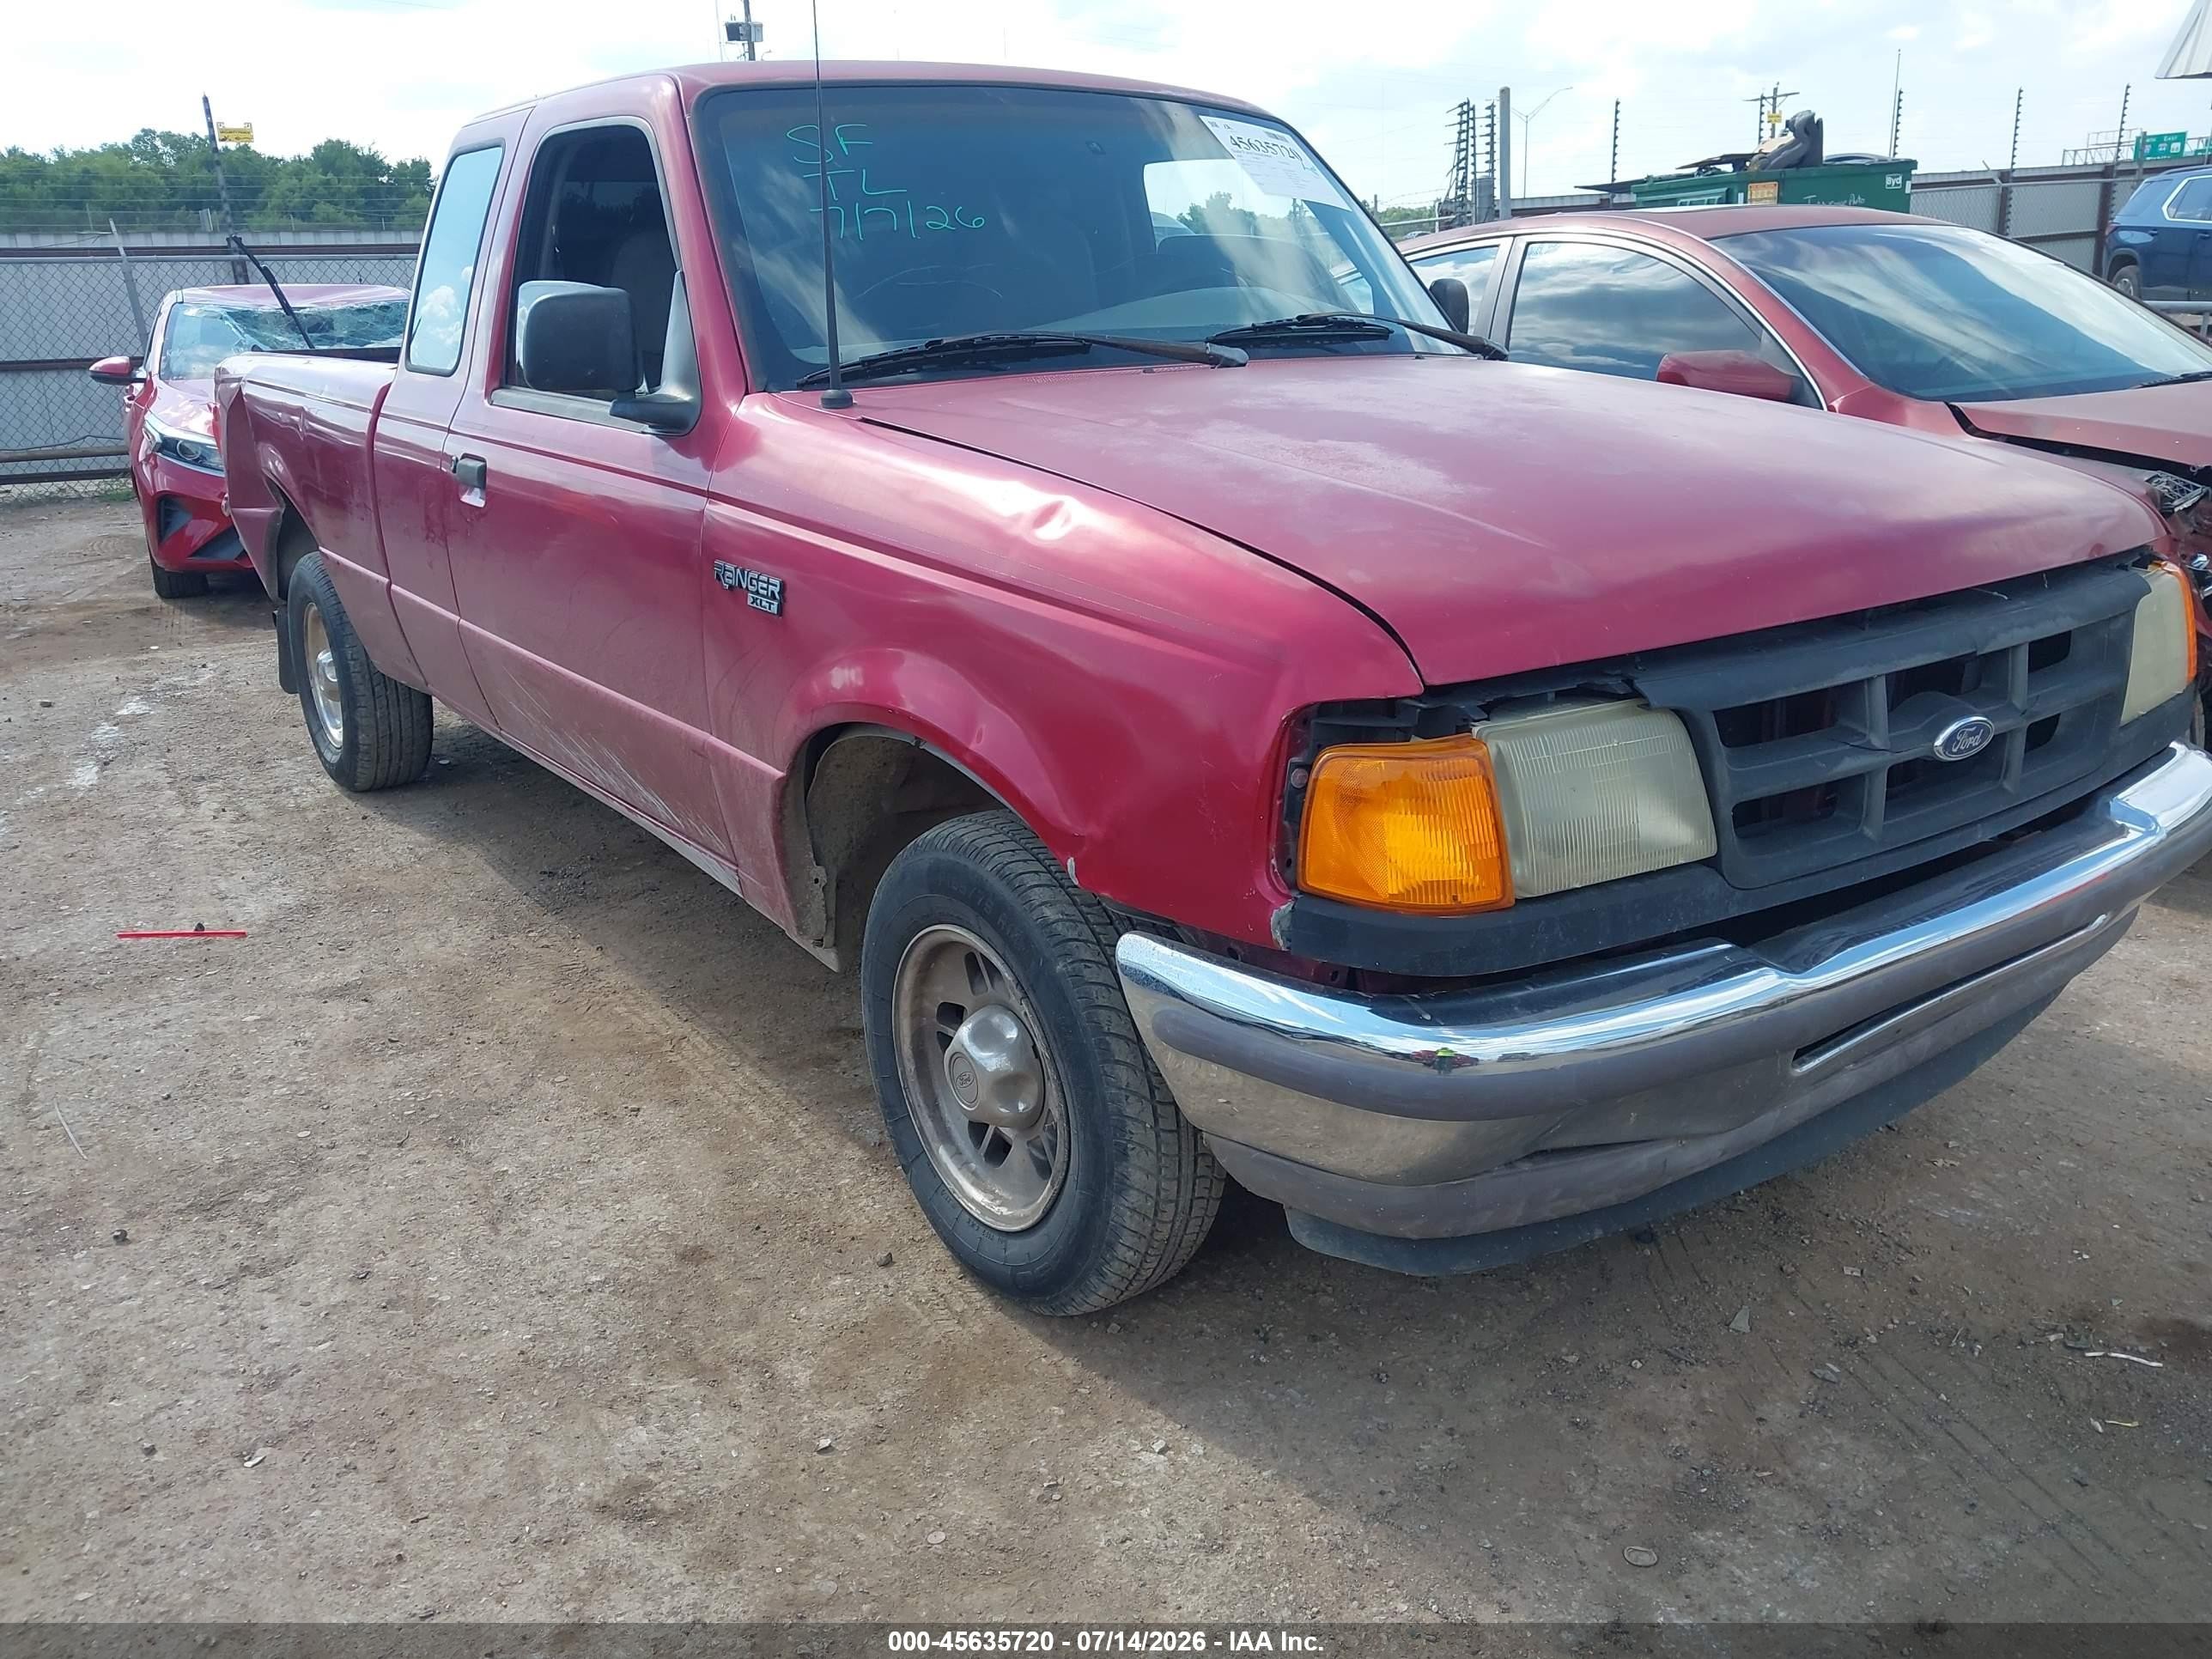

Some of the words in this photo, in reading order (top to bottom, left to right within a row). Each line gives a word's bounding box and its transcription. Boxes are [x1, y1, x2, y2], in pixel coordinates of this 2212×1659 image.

[787, 124, 873, 164] SF
[714, 559, 782, 600] RANGER
[750, 596, 775, 612] XLT
[1951, 725, 1984, 753] Ford
